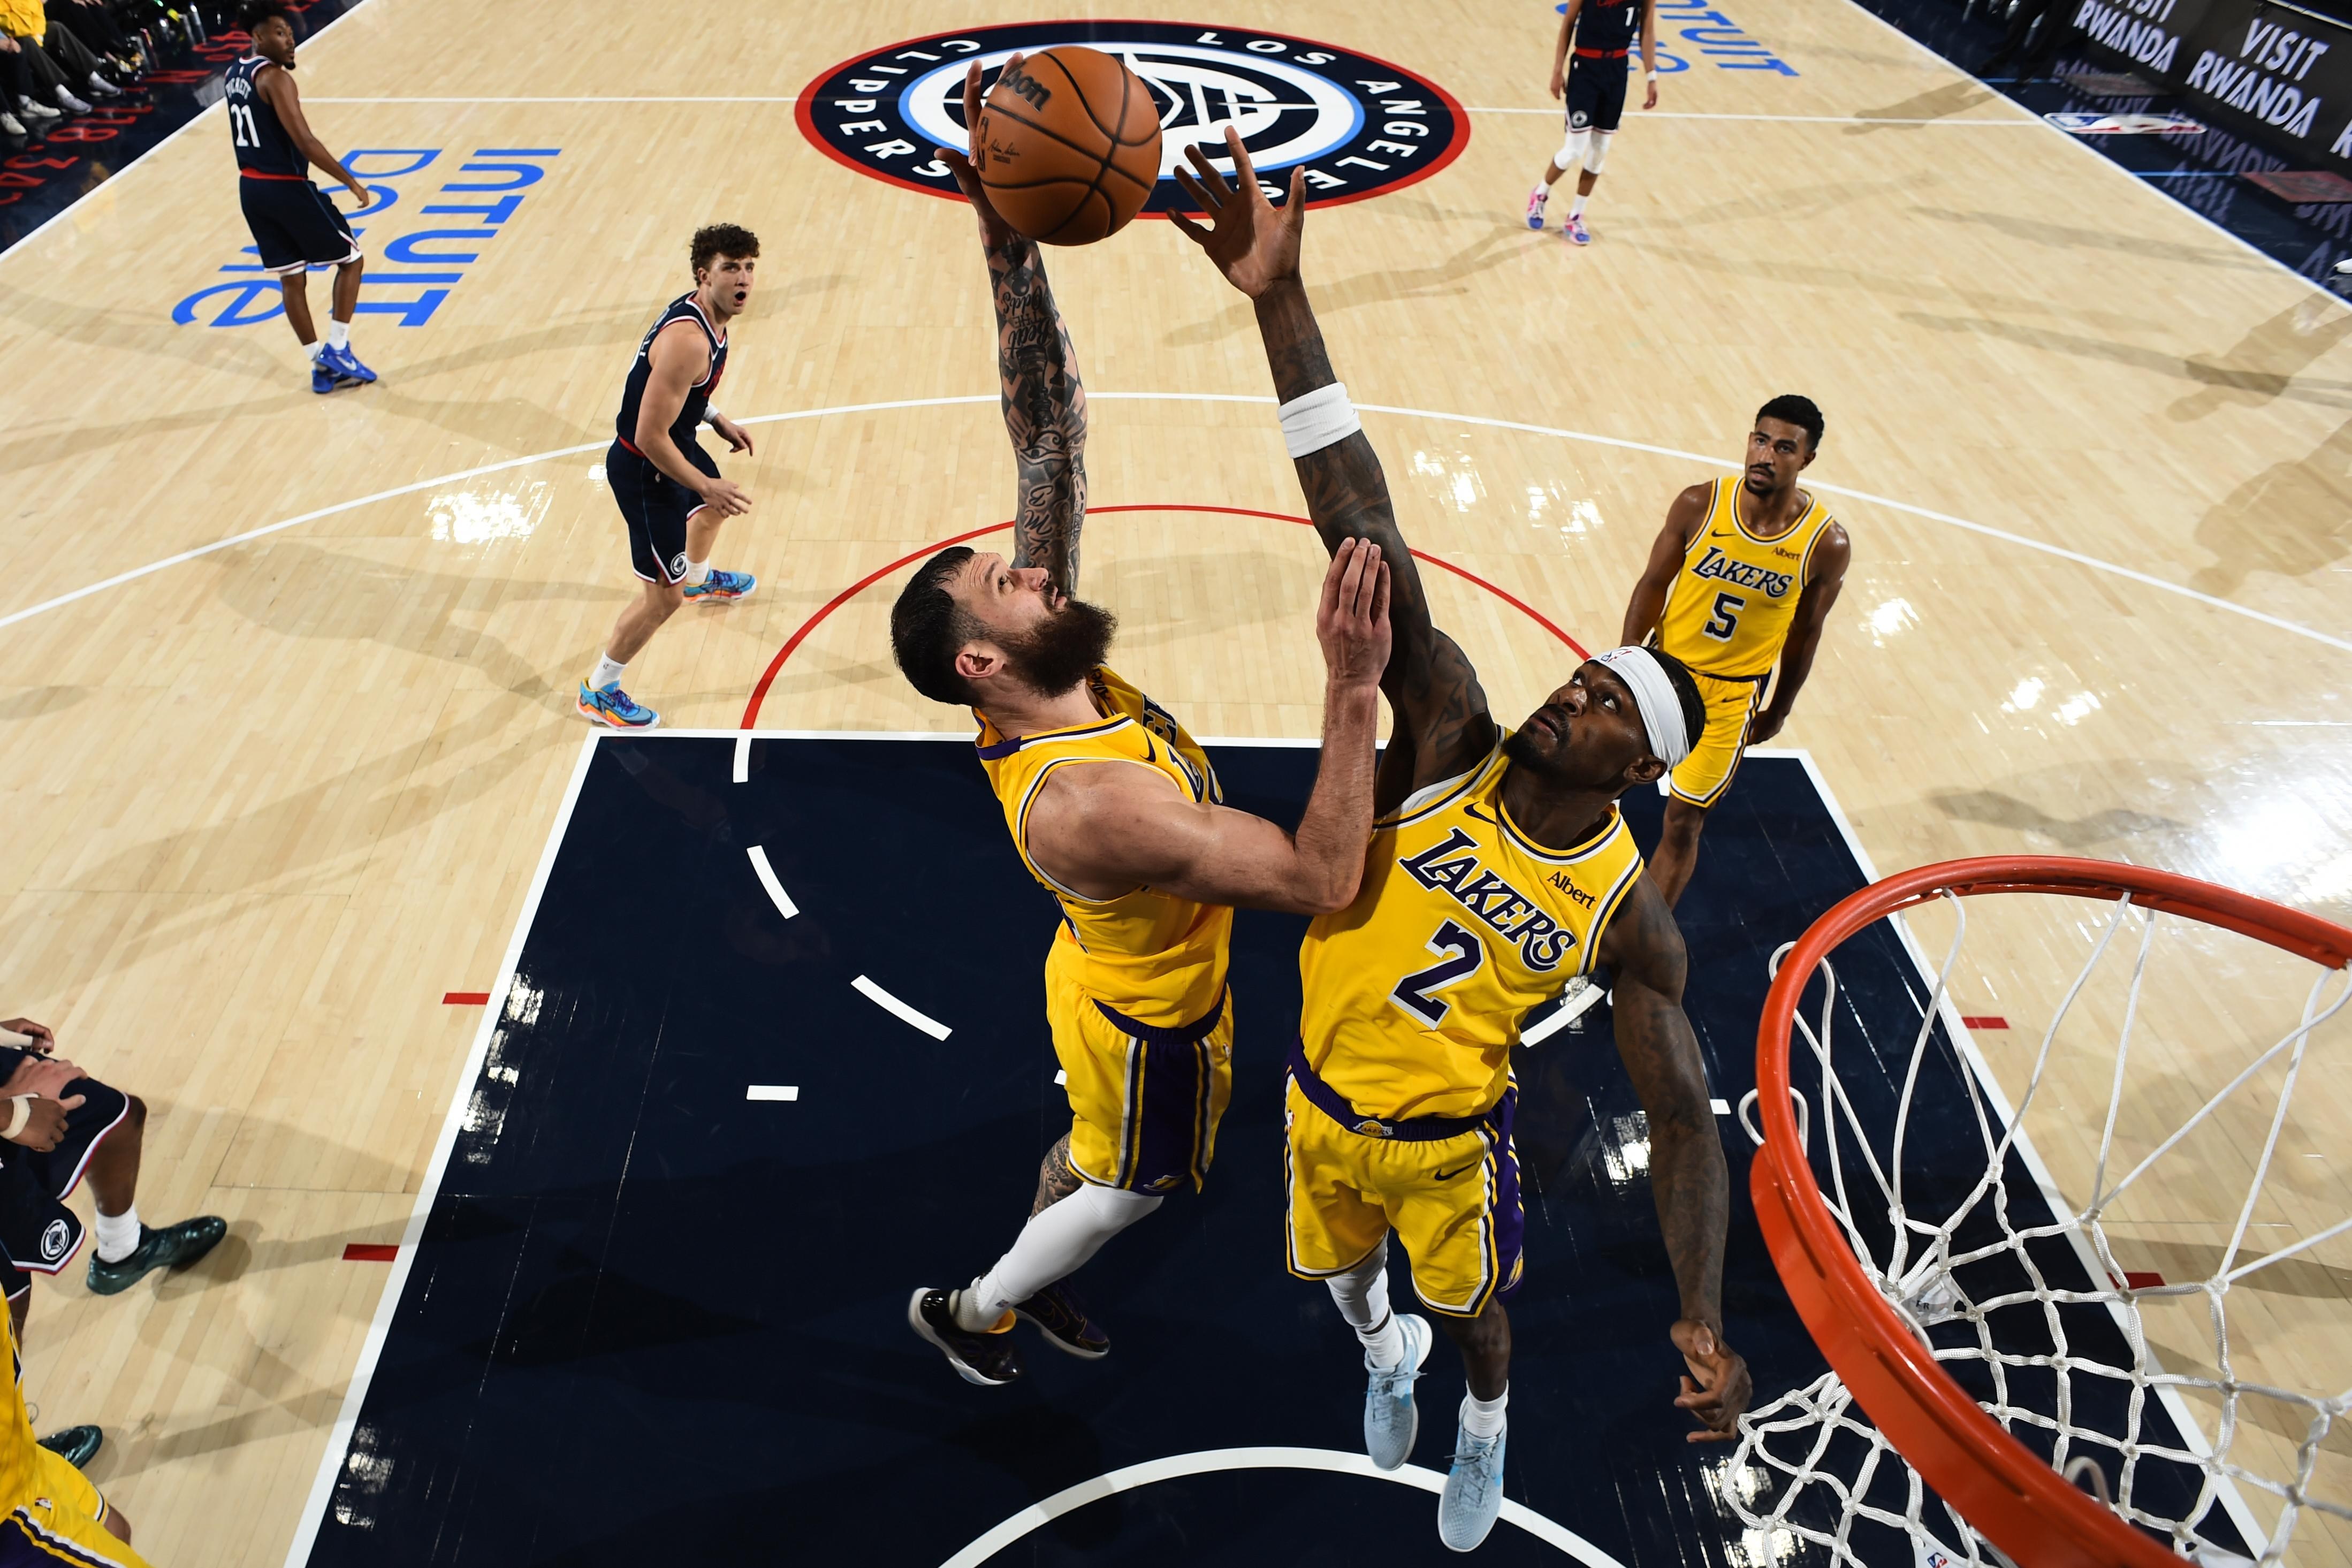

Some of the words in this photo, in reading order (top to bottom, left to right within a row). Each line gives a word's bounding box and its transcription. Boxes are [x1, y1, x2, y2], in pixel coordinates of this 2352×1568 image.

[1625, 6, 1634, 27] 1
[2073, 0, 2180, 73] RWANDA
[1196, 32, 1337, 65] LOS
[2239, 18, 2330, 81] VISIT
[834, 40, 980, 177] CLIPPERS
[2184, 50, 2321, 139] RWANDA
[231, 103, 261, 148] 21
[1691, 545, 1794, 599] LAKERS
[1771, 546, 1801, 561] Albert
[1702, 590, 1746, 643] 5
[1396, 825, 1578, 973] LAKERS
[1546, 870, 1597, 910] Albert
[1387, 917, 1485, 1031] 2
